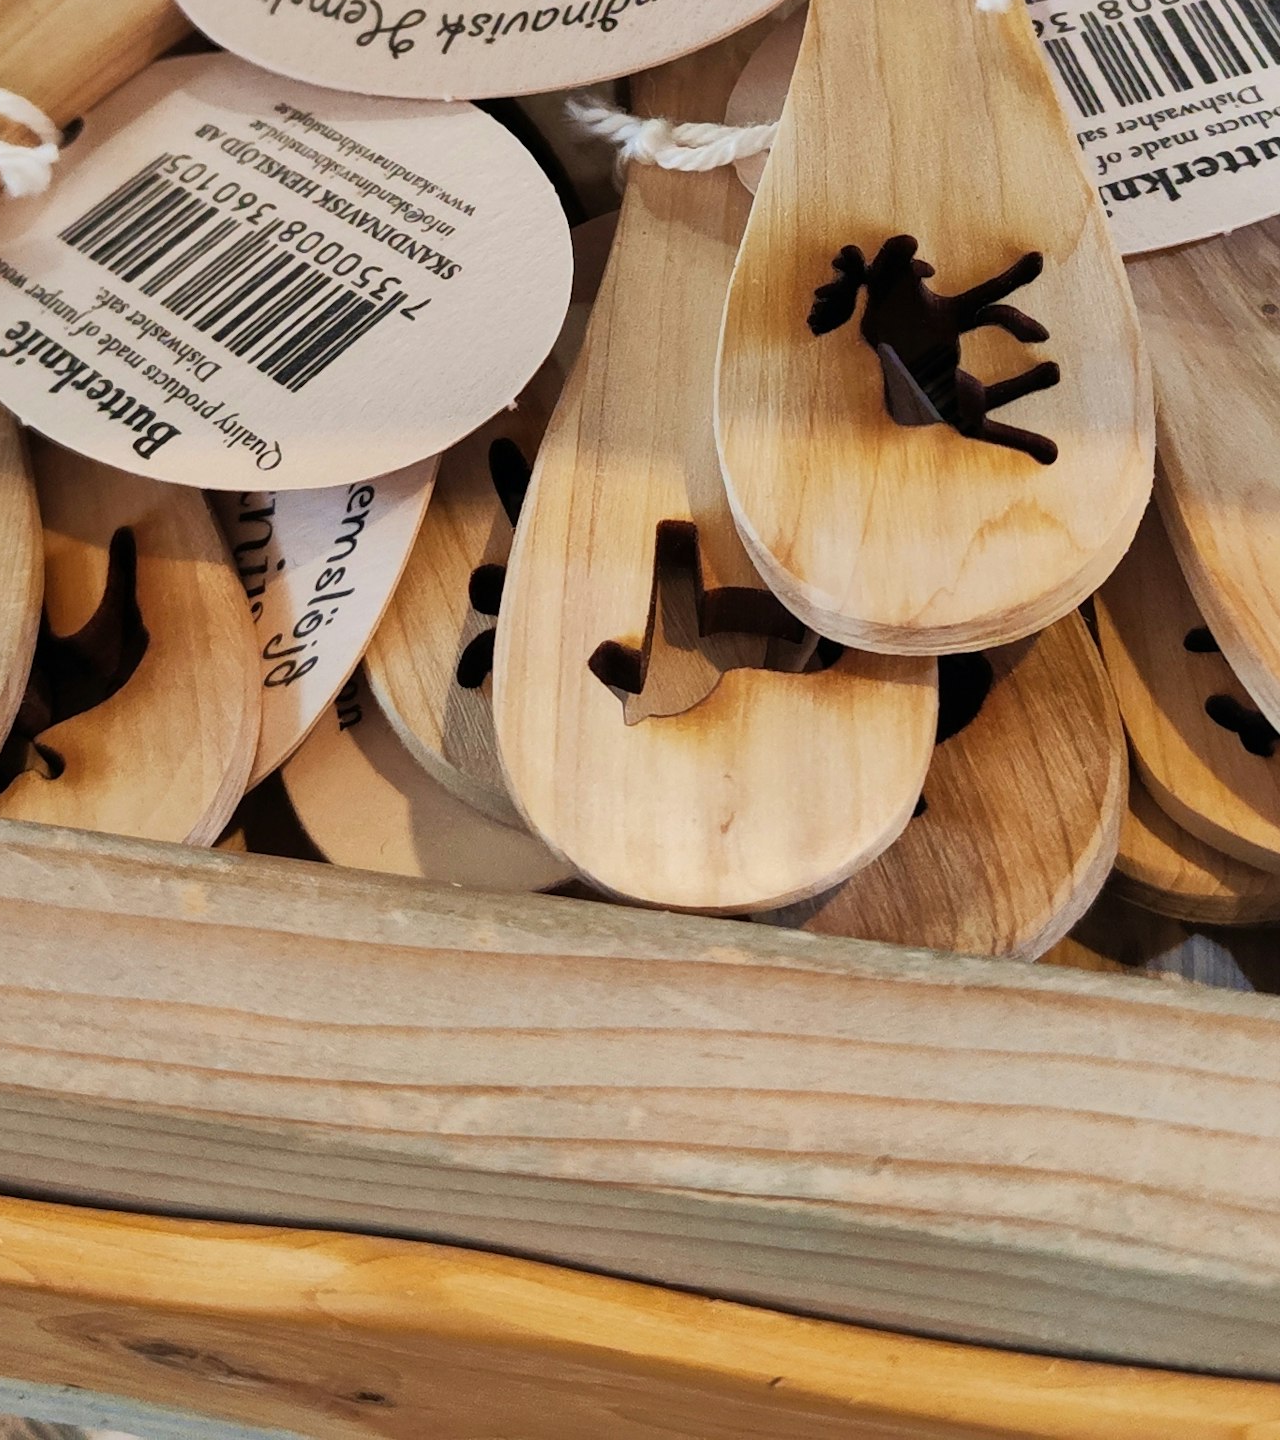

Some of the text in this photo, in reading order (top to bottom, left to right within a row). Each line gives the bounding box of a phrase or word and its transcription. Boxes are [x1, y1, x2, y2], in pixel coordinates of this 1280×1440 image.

[1116, 84, 1266, 136] Dishwasher
[273, 101, 477, 218] www.skandinaviskhemslojd.se
[1097, 151, 1123, 176] of
[1130, 129, 1200, 161] made
[194, 122, 464, 282] SKANDINAVISK HEMSLÖJD AB
[162, 152, 433, 322] 7 350008 360105
[25, 282, 94, 331] juniper
[67, 319, 101, 337] of
[97, 333, 148, 369] made
[124, 309, 223, 384] Dishwasher
[142, 363, 227, 421] products
[212, 411, 283, 472] Quality
[262, 482, 376, 689] emslöjd
